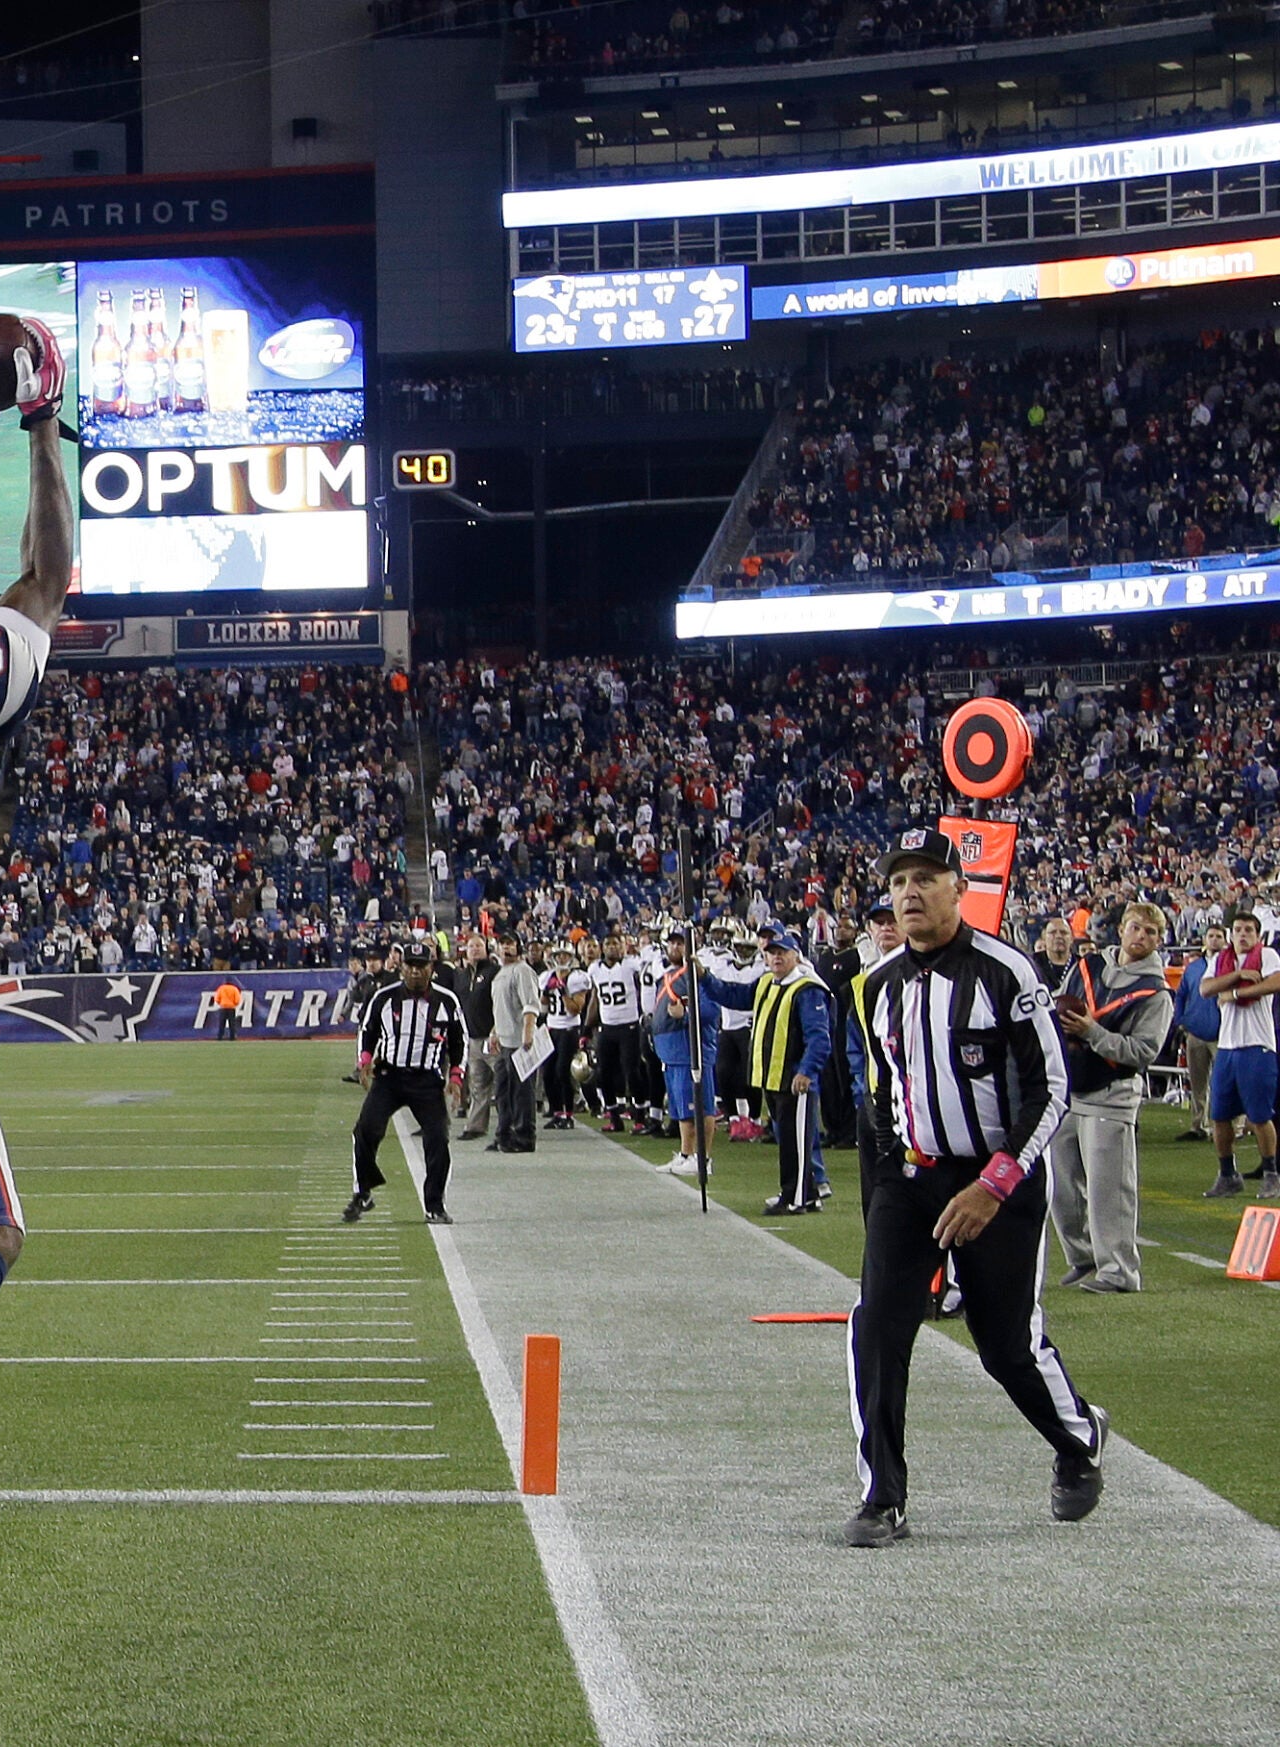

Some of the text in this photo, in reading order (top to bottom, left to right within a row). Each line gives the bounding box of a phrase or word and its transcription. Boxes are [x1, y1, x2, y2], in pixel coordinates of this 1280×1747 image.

[979, 149, 1134, 188] WELCOME
[24, 200, 229, 228] PATRIOTS
[1140, 252, 1254, 283] Putnam
[652, 285, 675, 305] 17
[783, 293, 802, 315] A
[806, 287, 870, 313] world
[872, 284, 898, 307] of
[525, 313, 565, 345] 23
[693, 303, 735, 336] 27
[81, 445, 366, 513] OPTUM
[401, 455, 448, 484] 40
[1022, 587, 1052, 616] T.
[1061, 577, 1170, 613] BRADY
[1184, 575, 1207, 604] 2
[1222, 572, 1267, 598] ATT
[207, 619, 360, 644] LOCKER ROOM
[905, 738, 915, 749] 12
[599, 981, 626, 1006] 52
[1019, 988, 1051, 1015] 60
[193, 991, 361, 1029] PATRI
[1235, 1210, 1276, 1274] 10
